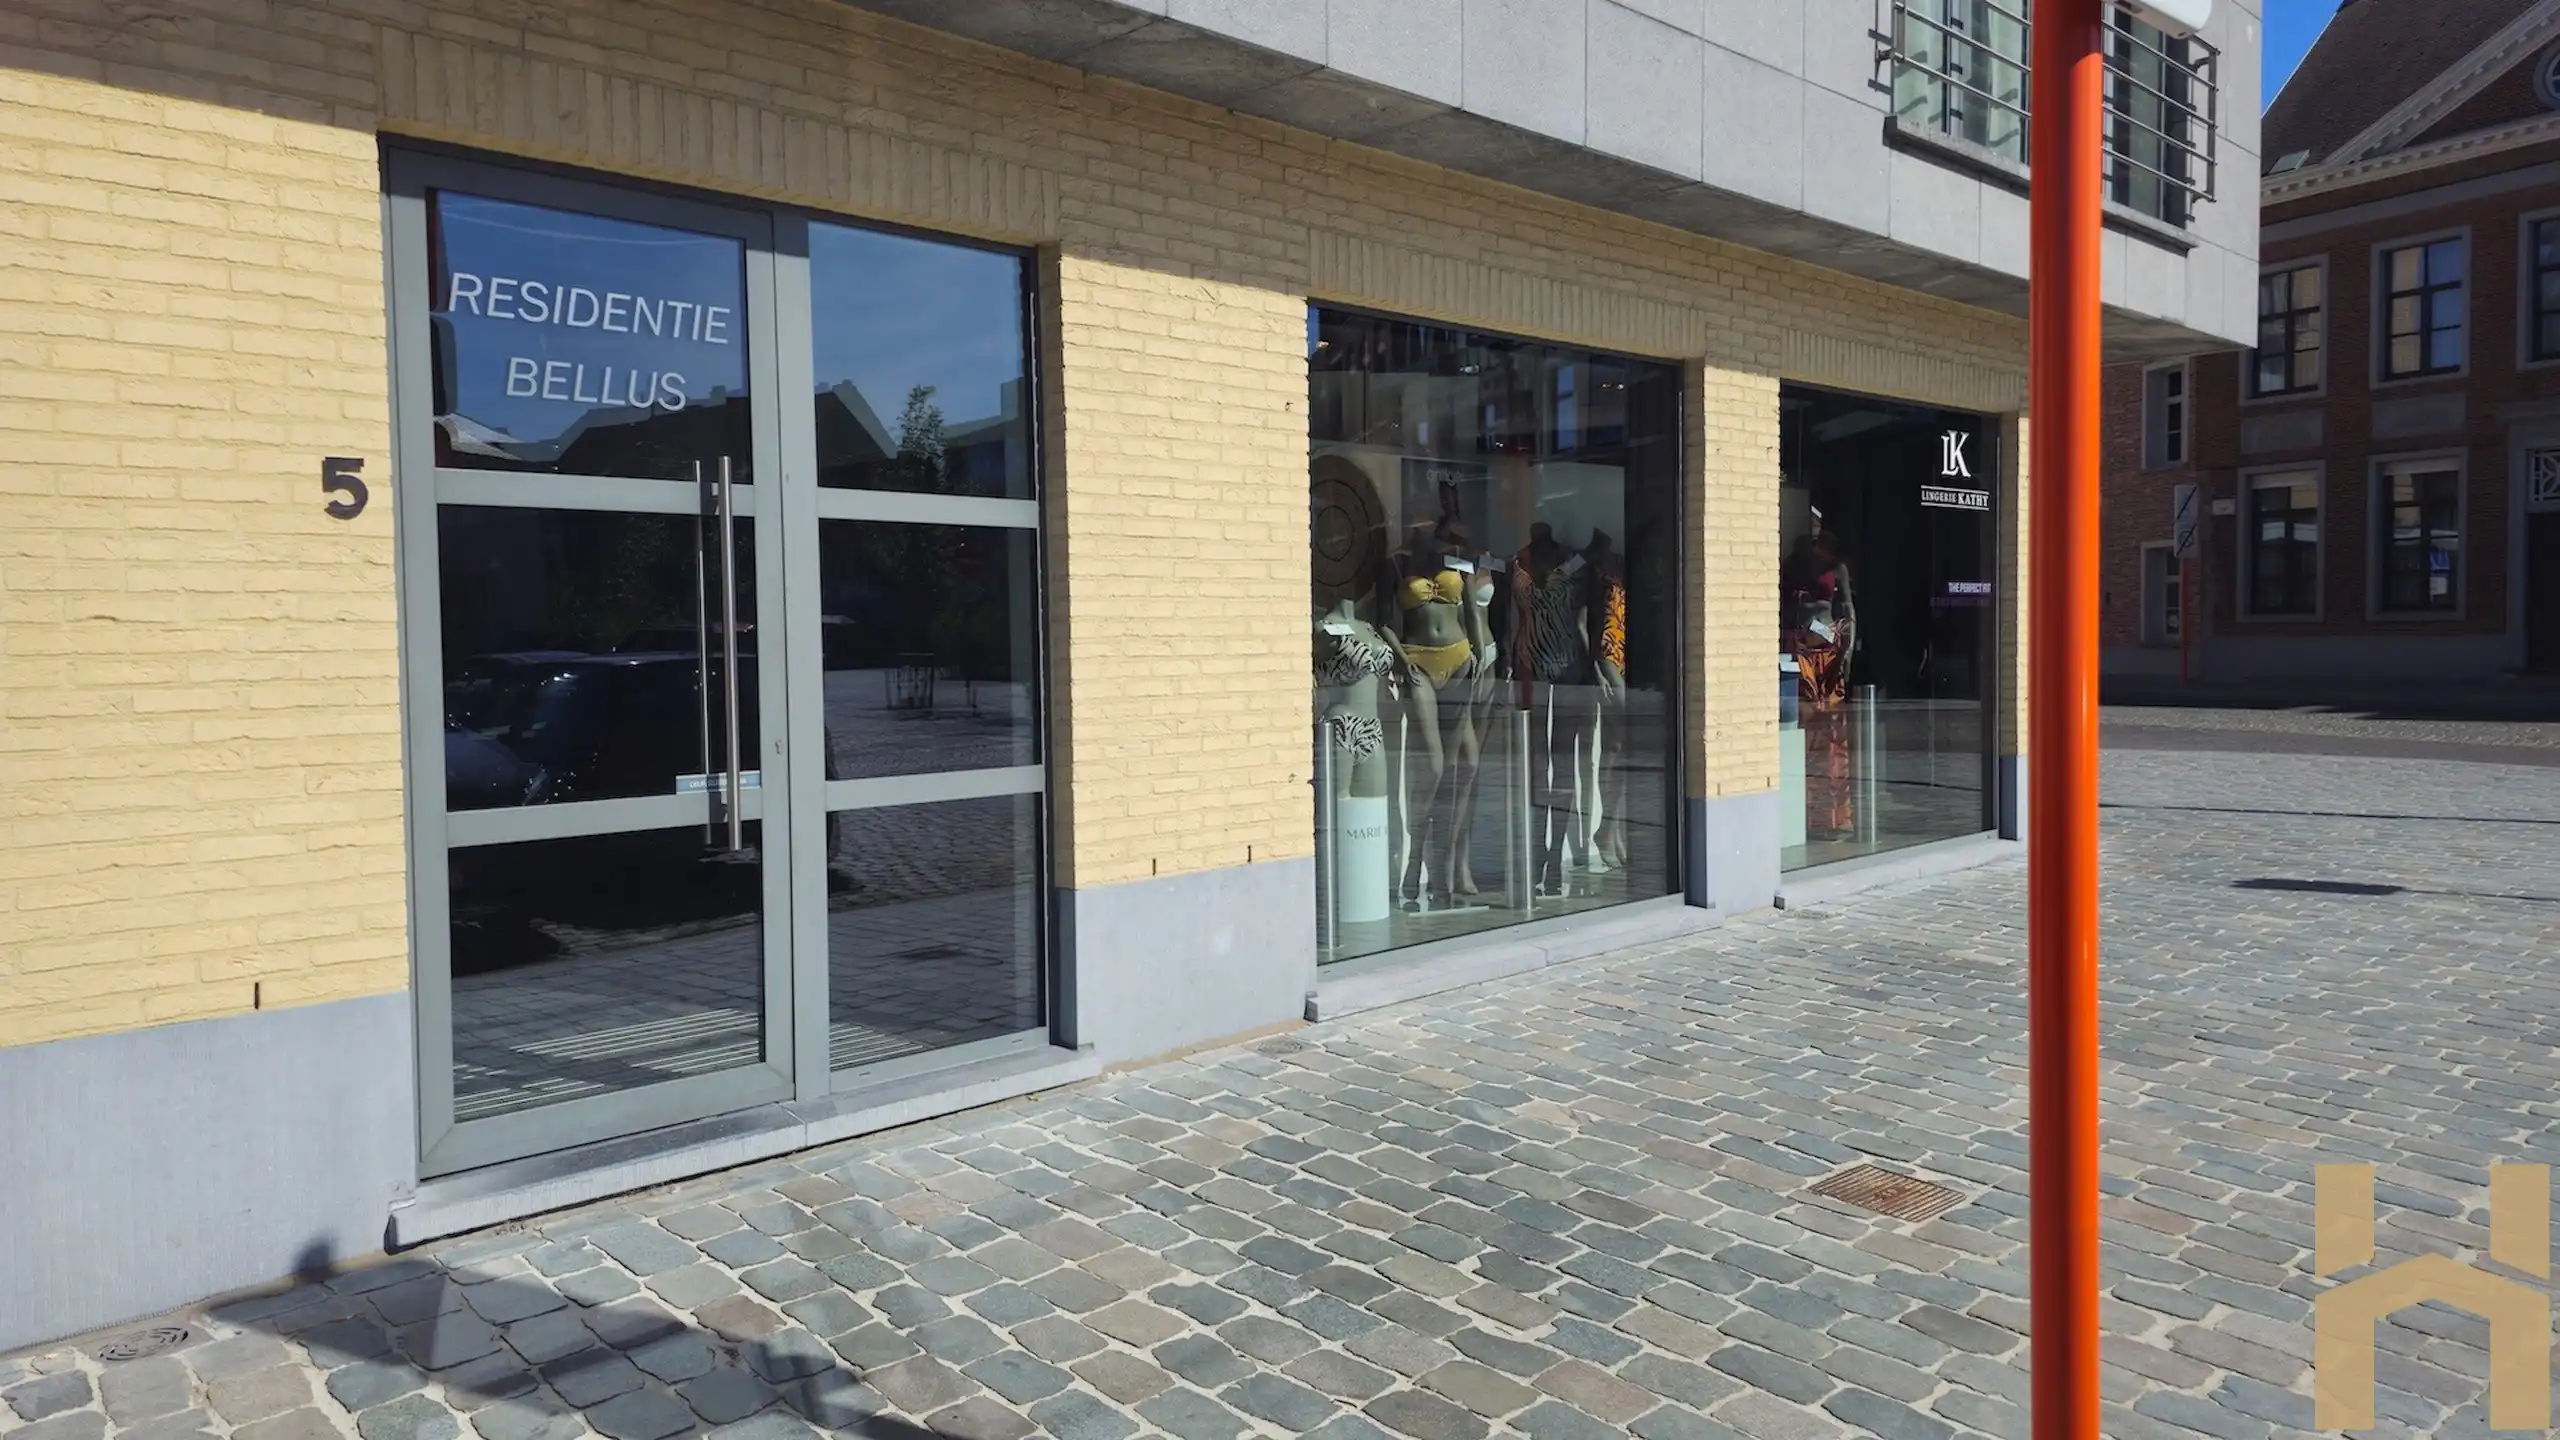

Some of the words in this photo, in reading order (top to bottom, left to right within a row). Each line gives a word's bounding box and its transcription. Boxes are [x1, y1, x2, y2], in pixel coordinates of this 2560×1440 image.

[449, 272, 731, 345] RESIDENTIE
[506, 356, 687, 412] BELLUS
[322, 456, 369, 520] 5
[1921, 490, 1957, 504] LINGERIE
[1957, 492, 1989, 507] KATHY
